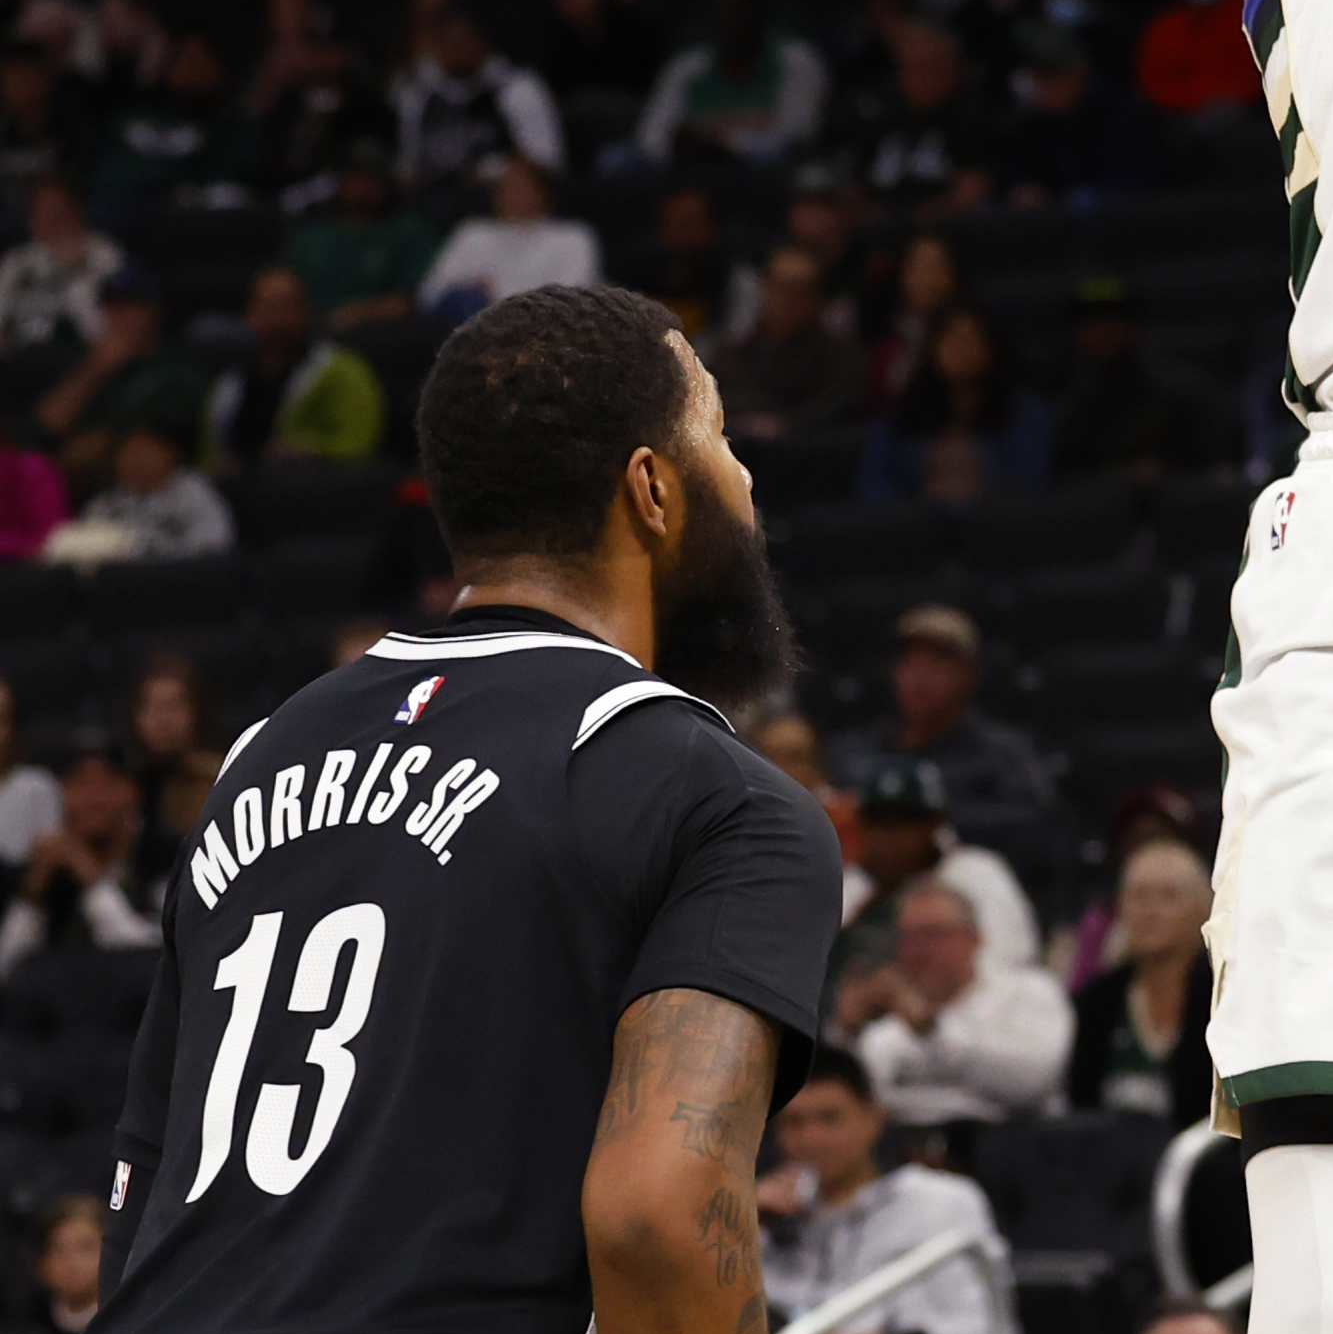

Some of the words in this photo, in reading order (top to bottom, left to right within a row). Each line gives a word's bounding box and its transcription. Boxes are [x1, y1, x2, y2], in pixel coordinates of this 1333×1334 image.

[190, 742, 432, 911] MORRIS
[405, 758, 500, 866] SR.
[185, 902, 387, 1204] 13
